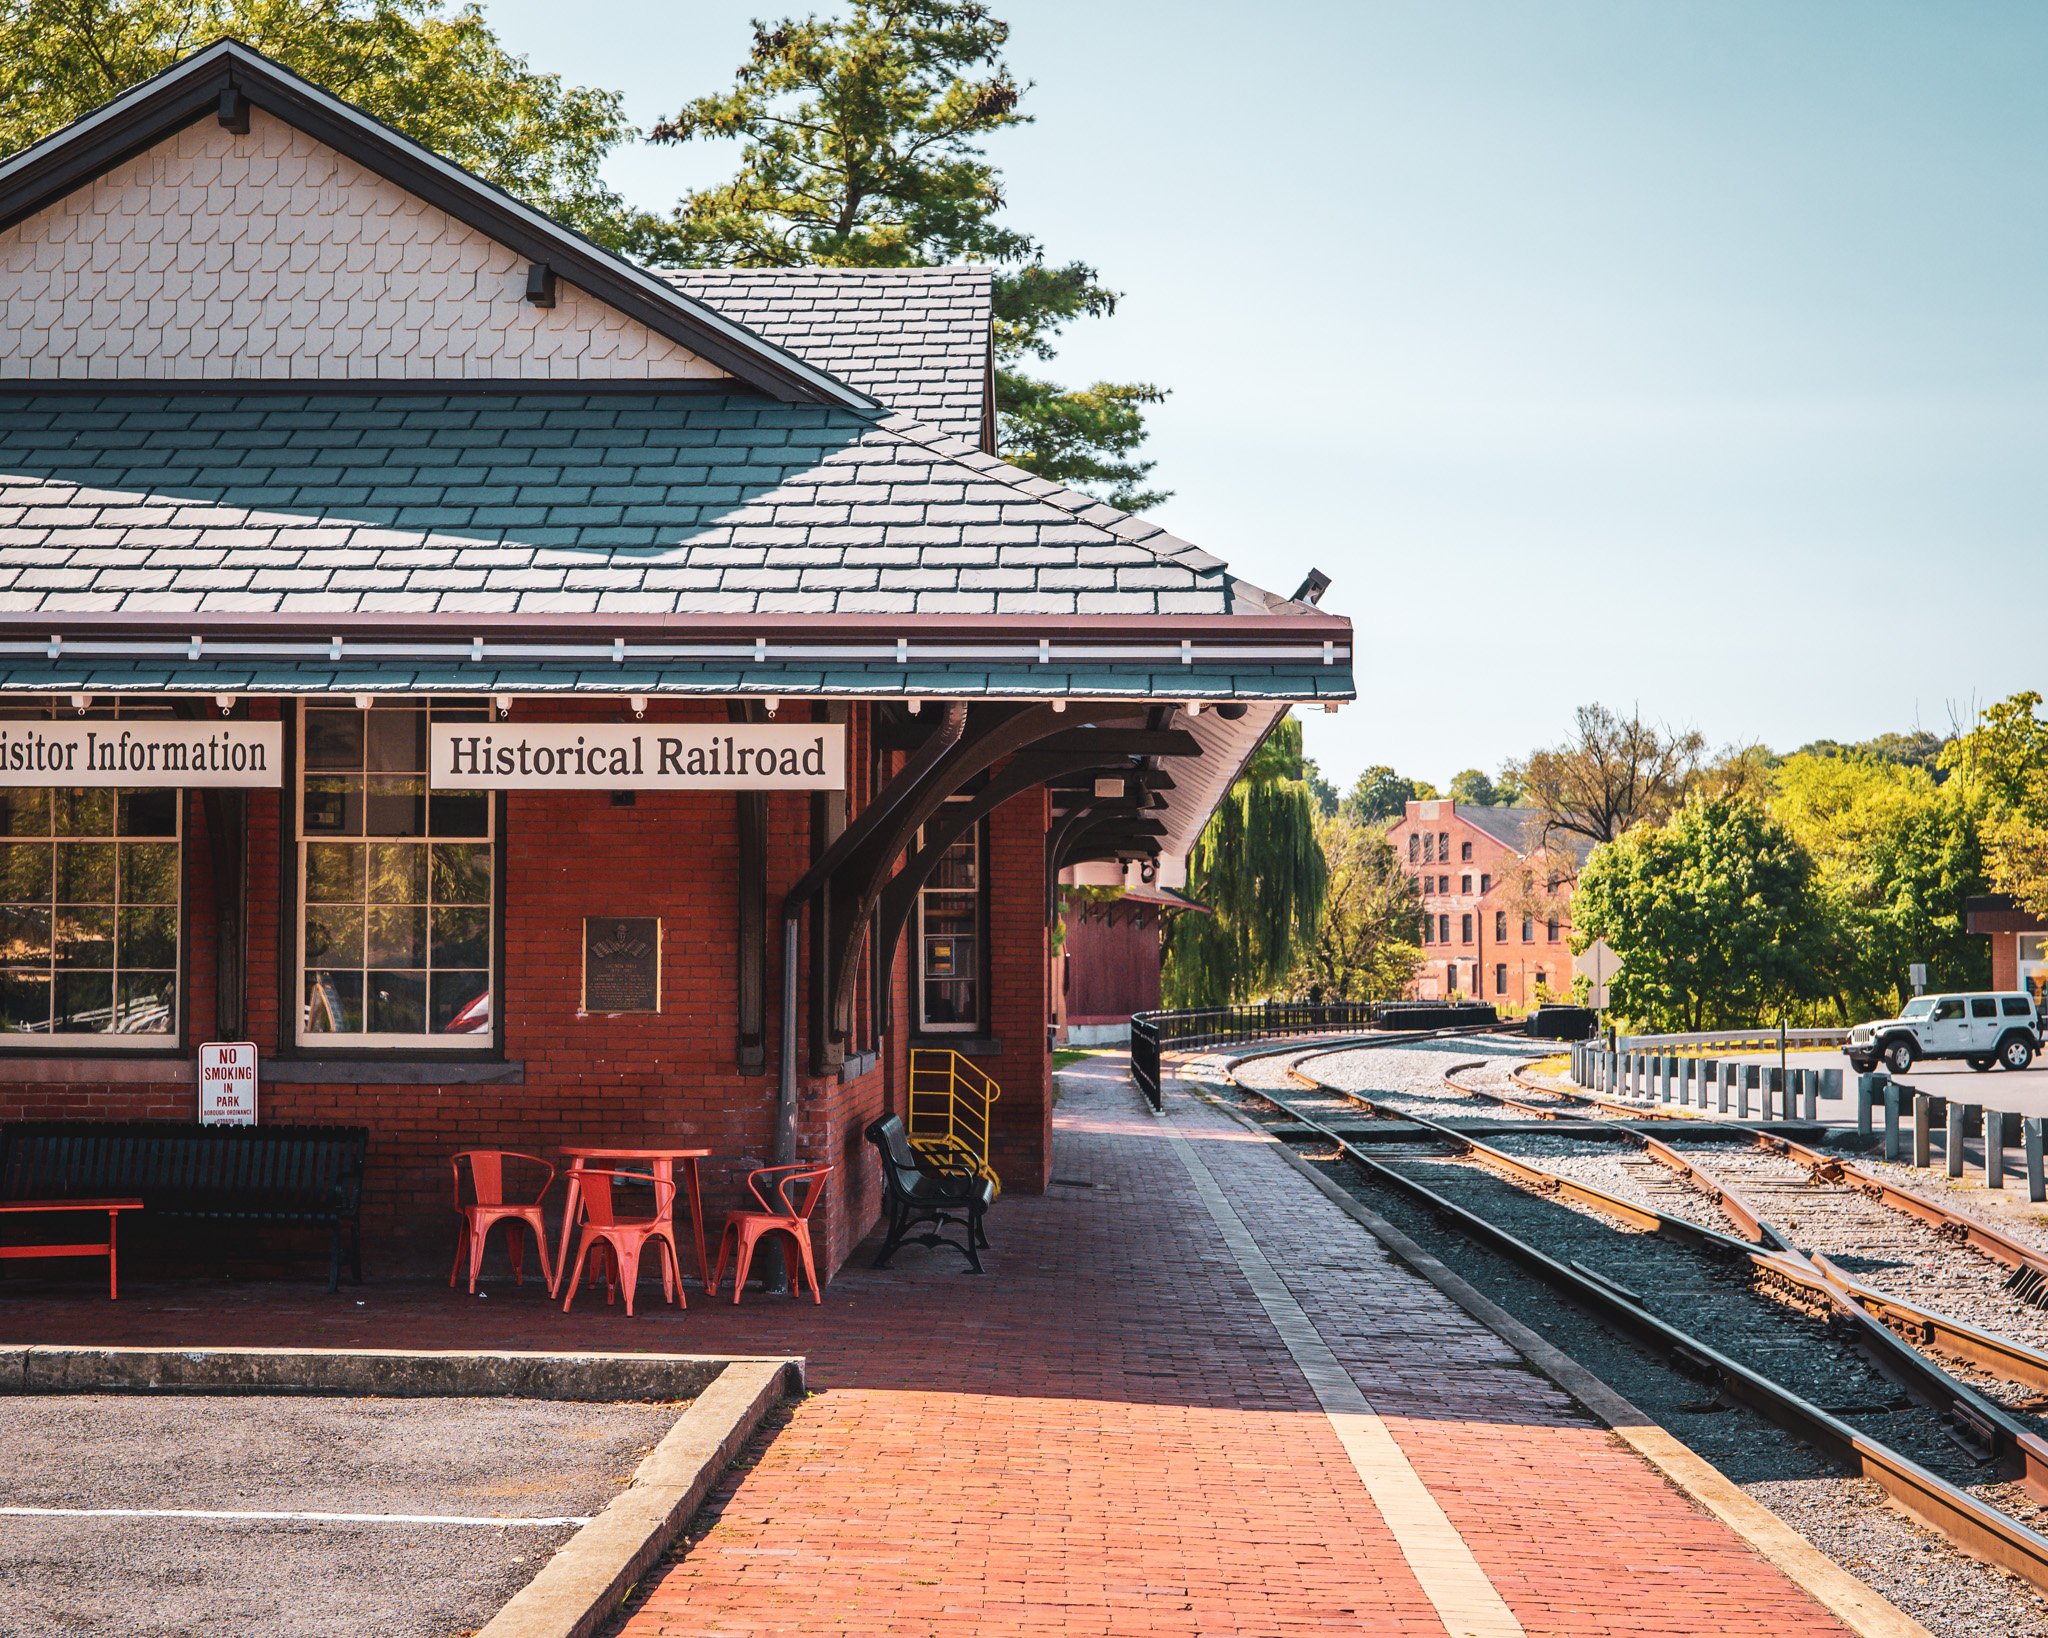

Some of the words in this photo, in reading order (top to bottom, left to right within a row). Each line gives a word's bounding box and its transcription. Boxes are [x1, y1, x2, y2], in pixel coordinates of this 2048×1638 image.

[86, 731, 267, 771] Information
[450, 736, 643, 775] Historical
[657, 736, 826, 775] Railroad
[219, 1049, 237, 1064] NO
[205, 1067, 252, 1080] SMOKING
[223, 1083, 233, 1093] IN
[216, 1097, 240, 1107] PARK
